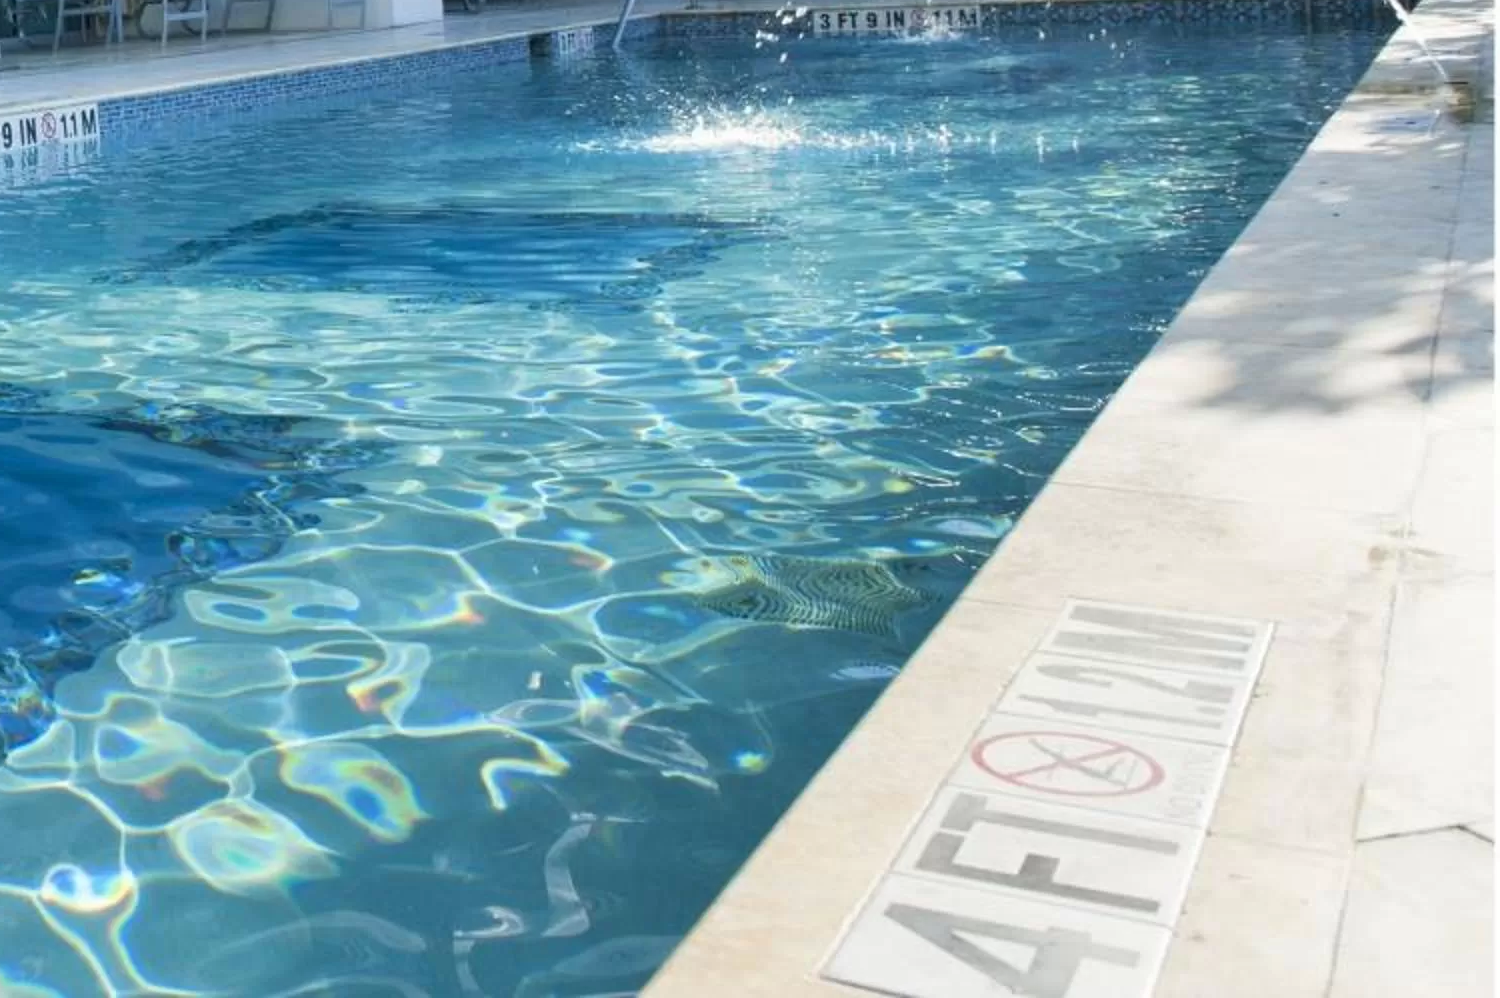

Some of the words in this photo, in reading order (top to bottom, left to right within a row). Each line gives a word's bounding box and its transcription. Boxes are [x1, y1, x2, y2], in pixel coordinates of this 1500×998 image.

[819, 13, 831, 30] 3
[838, 11, 859, 29] FT
[866, 11, 878, 28] 9
[886, 9, 905, 27] IN
[2, 122, 13, 150] 9
[20, 118, 38, 147] IN
[915, 792, 1180, 913] FT
[883, 902, 1141, 998] 4
